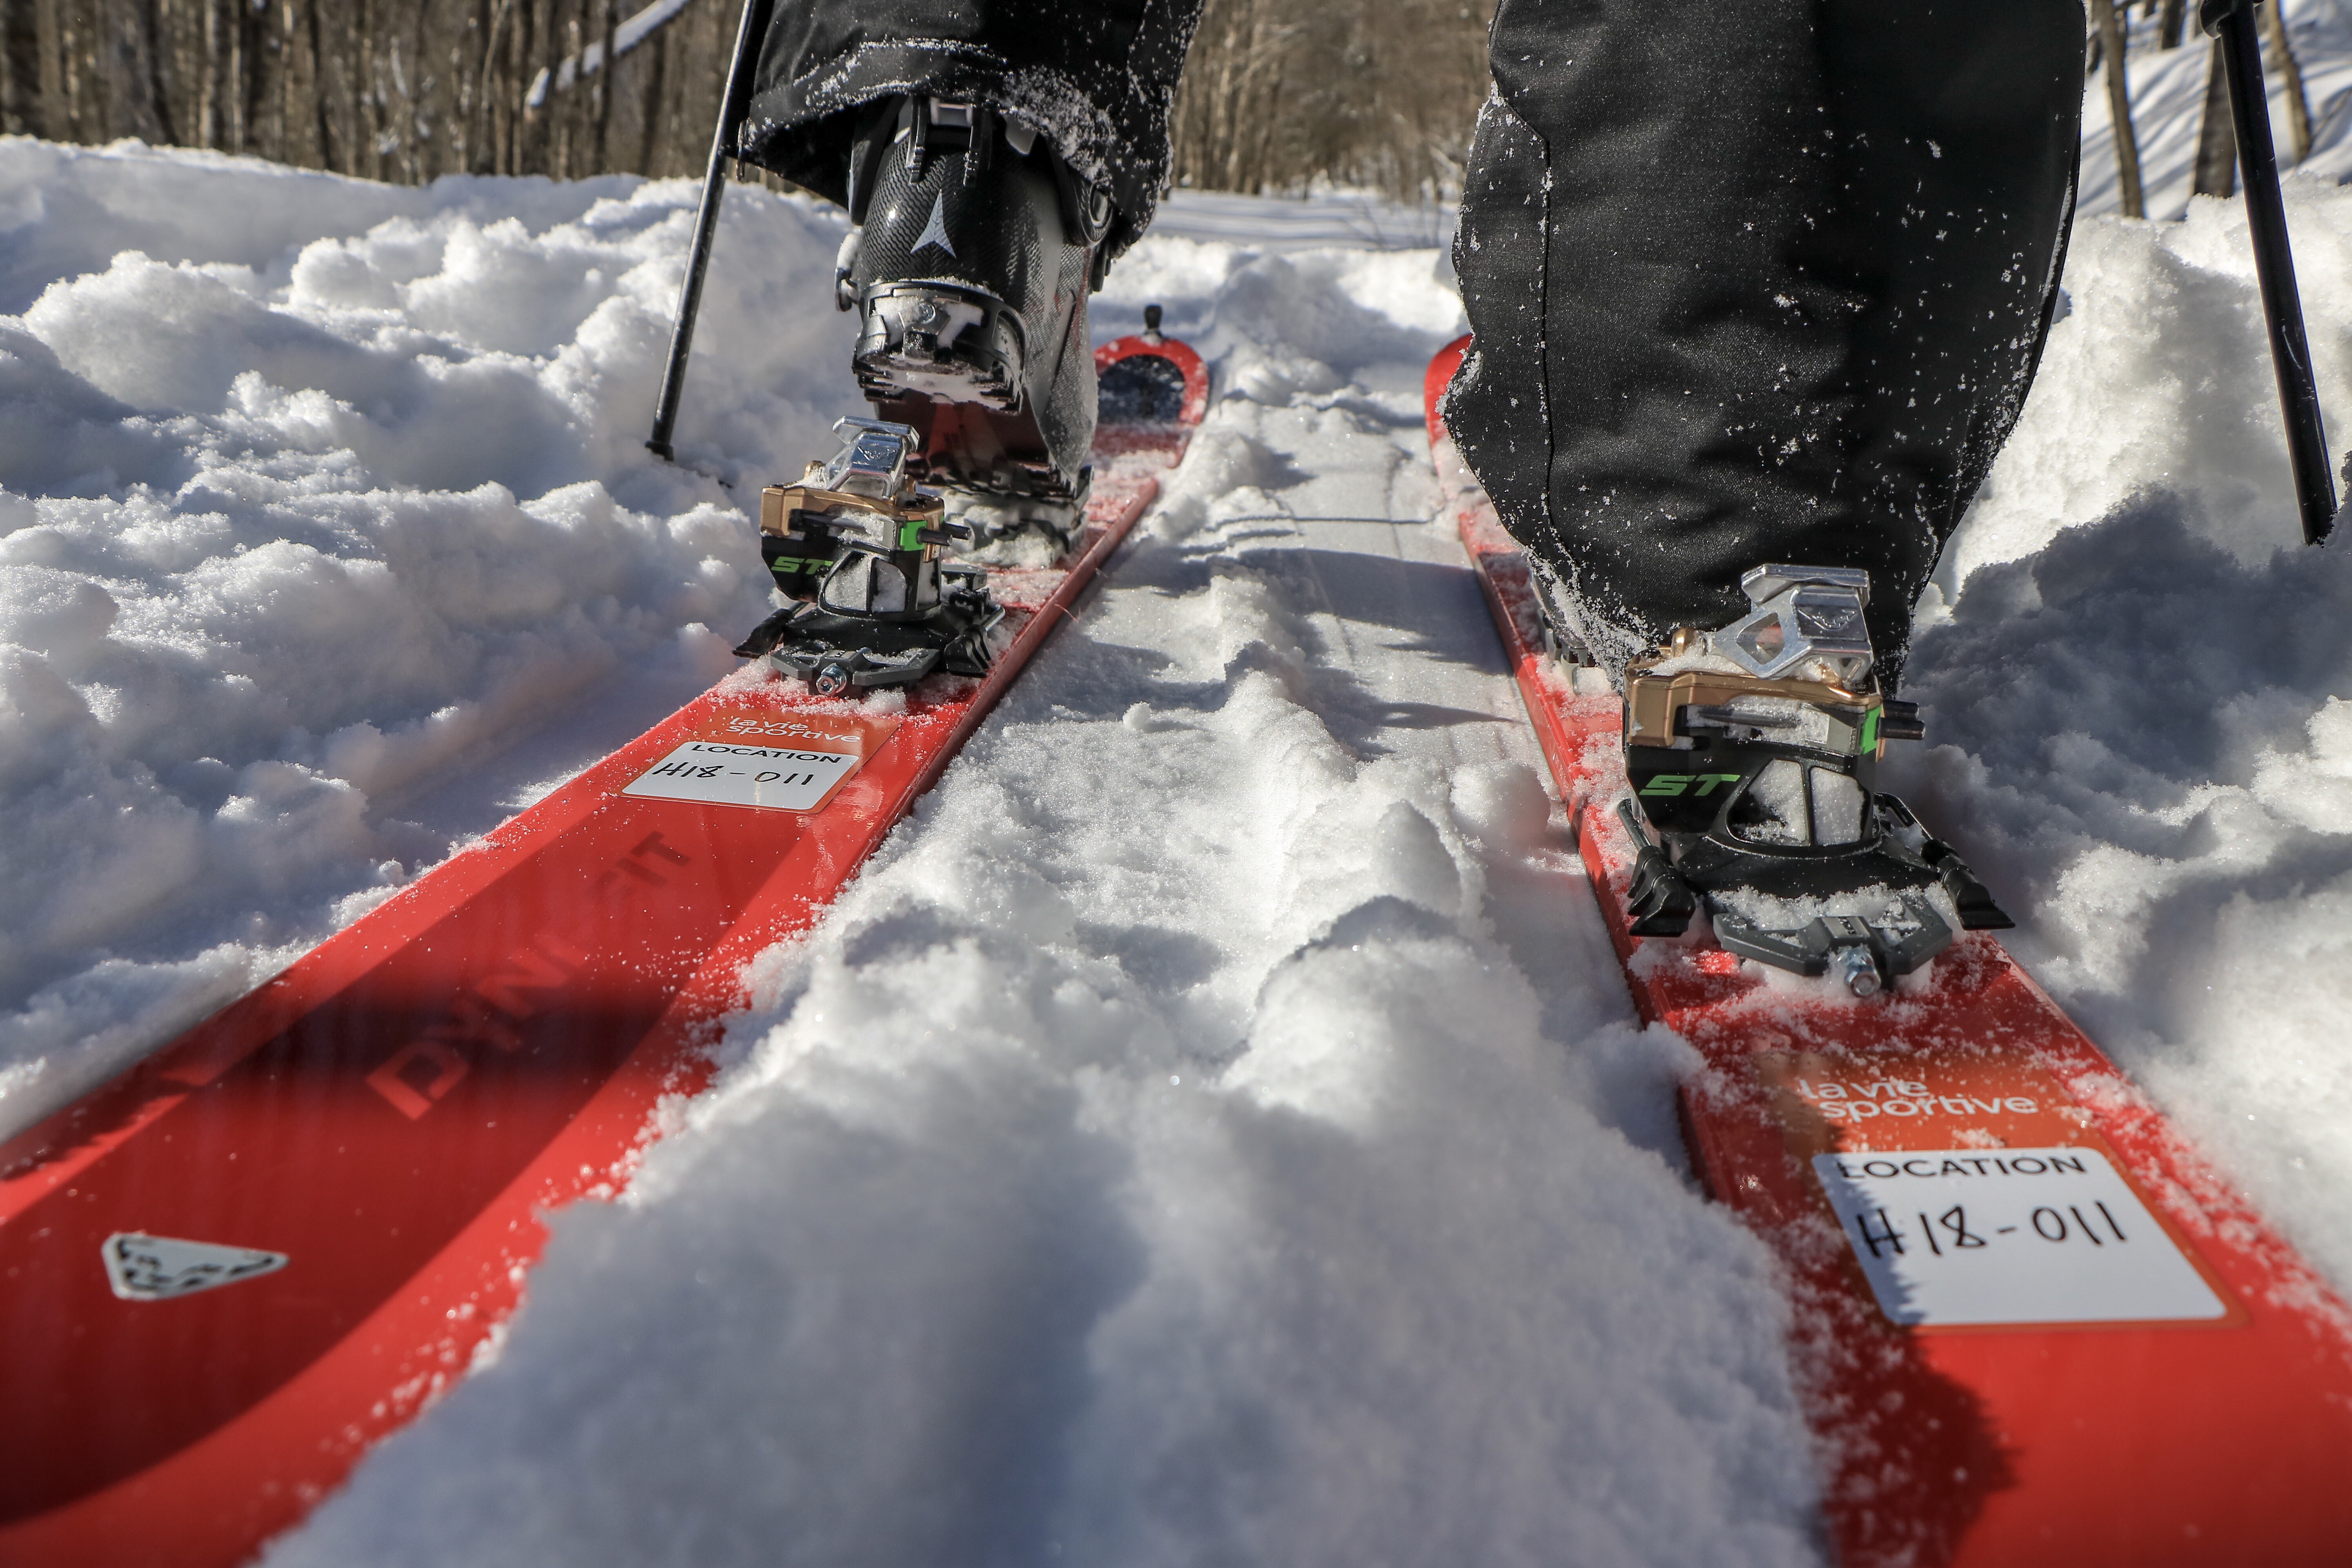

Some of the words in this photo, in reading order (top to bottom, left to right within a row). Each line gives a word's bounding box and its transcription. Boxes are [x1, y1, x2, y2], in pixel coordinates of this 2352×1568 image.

[771, 557, 833, 575] ST
[730, 717, 758, 726] la
[763, 720, 808, 730] vie
[726, 726, 861, 742] sportive
[692, 745, 842, 763] LOCATION
[1639, 774, 1740, 796] ST
[1800, 1080, 1848, 1099] la
[1849, 1080, 1928, 1098] vie
[1819, 1095, 2039, 1122] sportive
[1837, 1156, 2087, 1178] LOCATION
